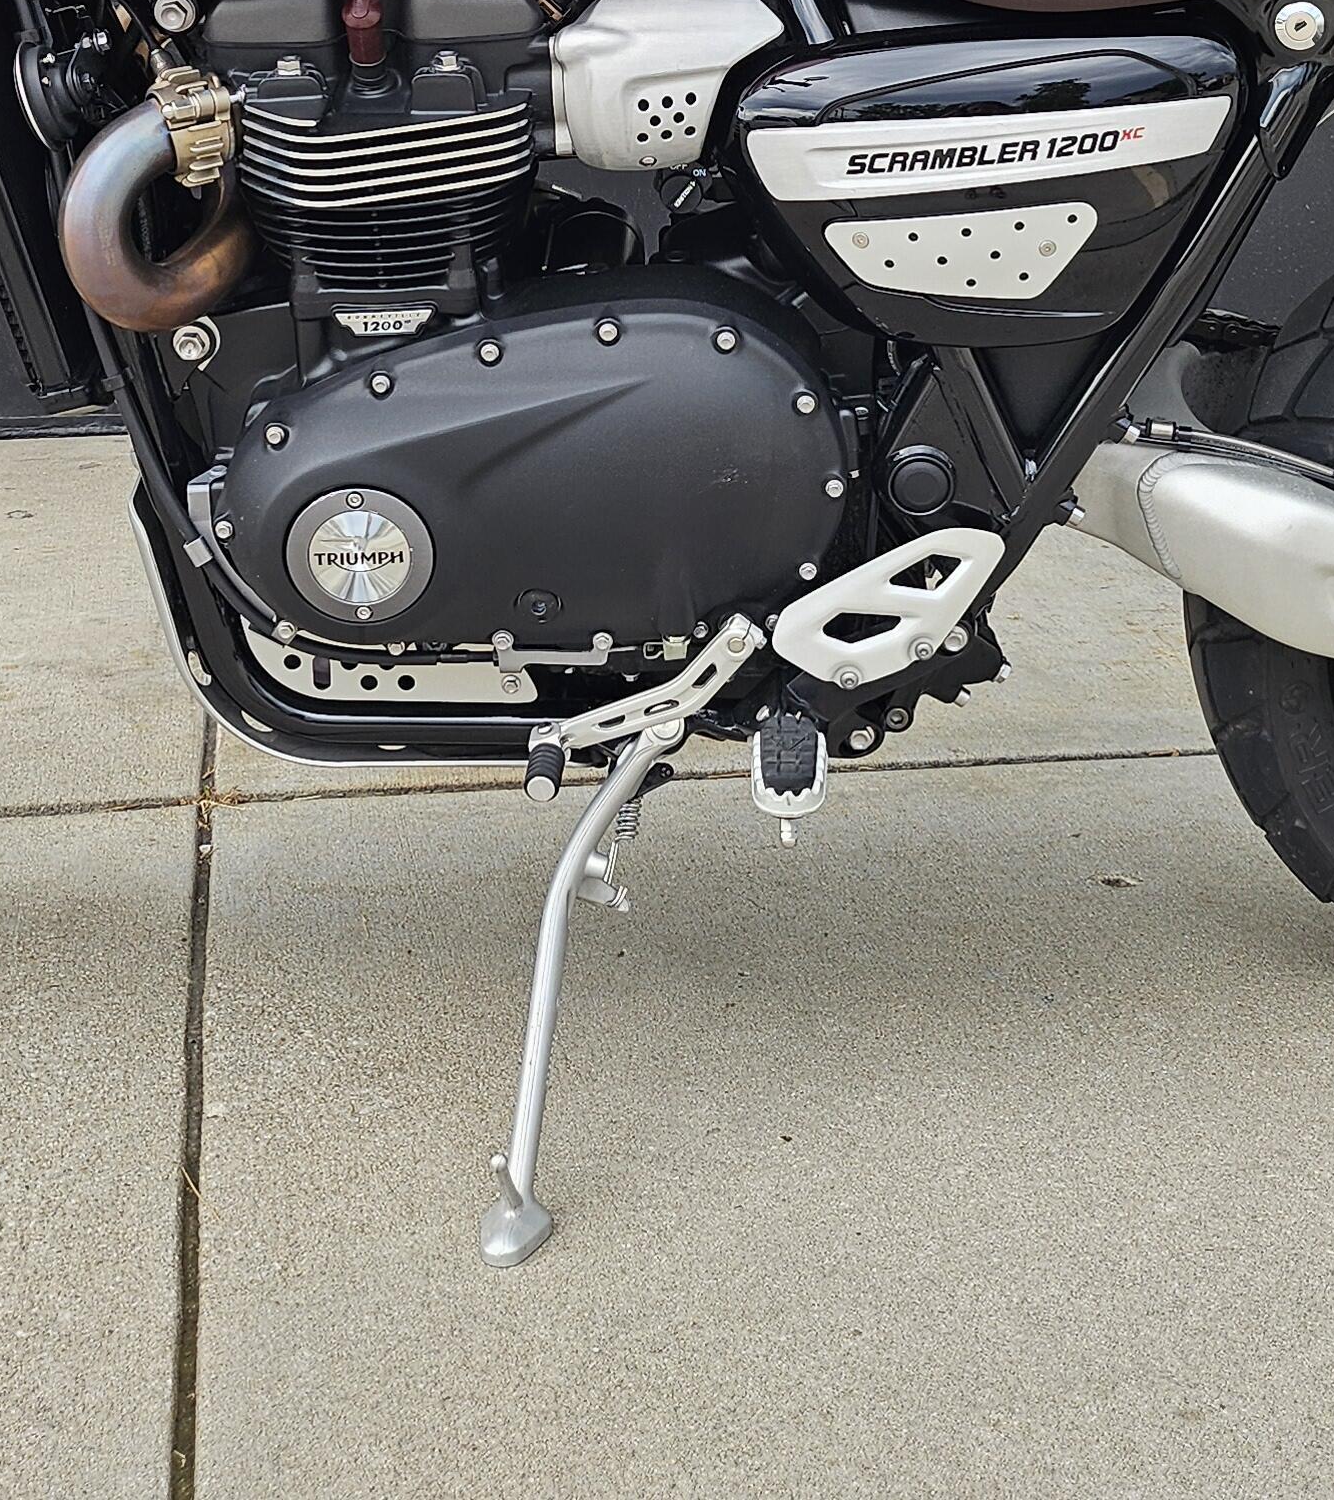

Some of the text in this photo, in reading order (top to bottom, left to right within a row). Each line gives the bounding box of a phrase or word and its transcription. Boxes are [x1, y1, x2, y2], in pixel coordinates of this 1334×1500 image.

[847, 140, 1040, 175] SCRAMBLER
[692, 168, 707, 177] ON
[362, 320, 403, 332] 1200
[314, 550, 404, 572] TRIUMPH
